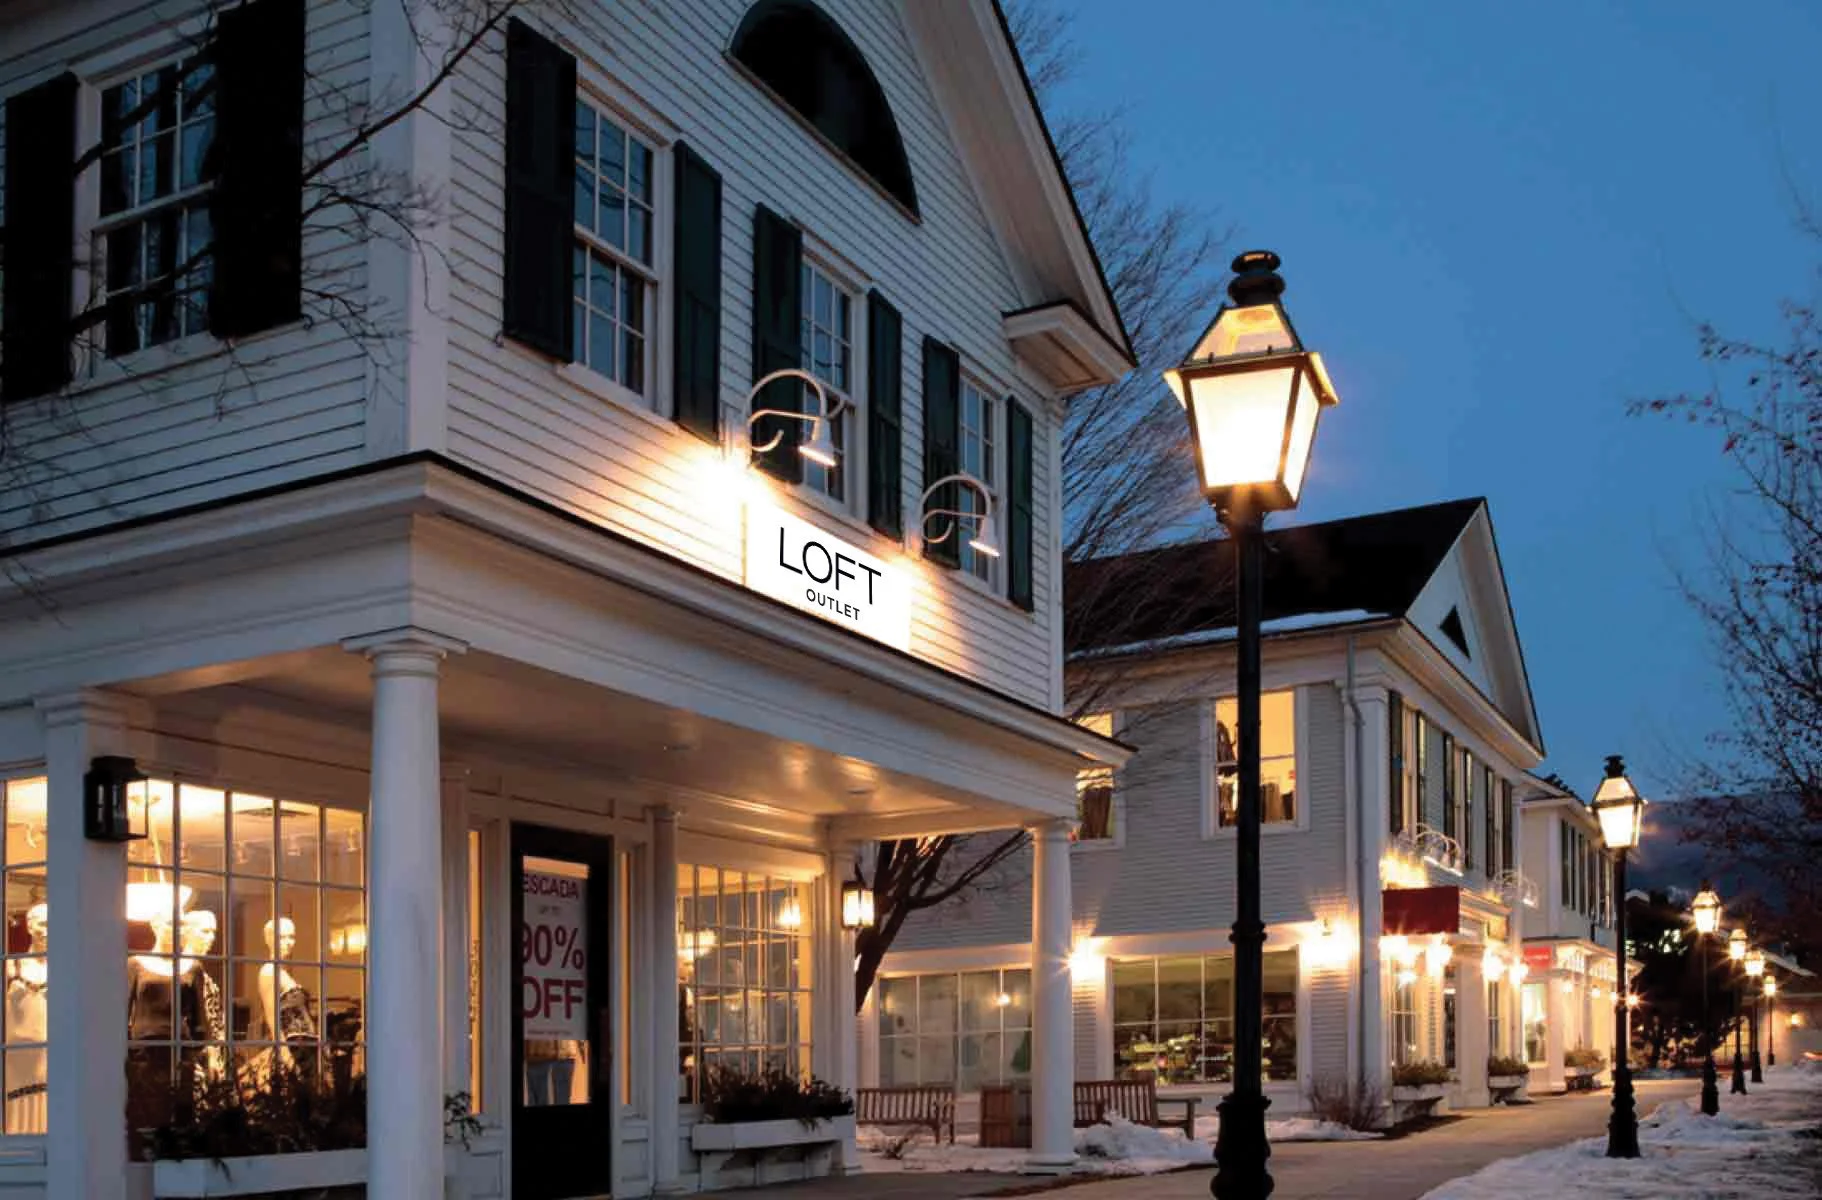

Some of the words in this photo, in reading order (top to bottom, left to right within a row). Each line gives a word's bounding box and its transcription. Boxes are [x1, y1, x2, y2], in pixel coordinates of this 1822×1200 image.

[779, 526, 882, 605] LOFT
[806, 588, 860, 621] OUTLET
[522, 873, 579, 899] ESCADA
[522, 976, 585, 1020] OFF
